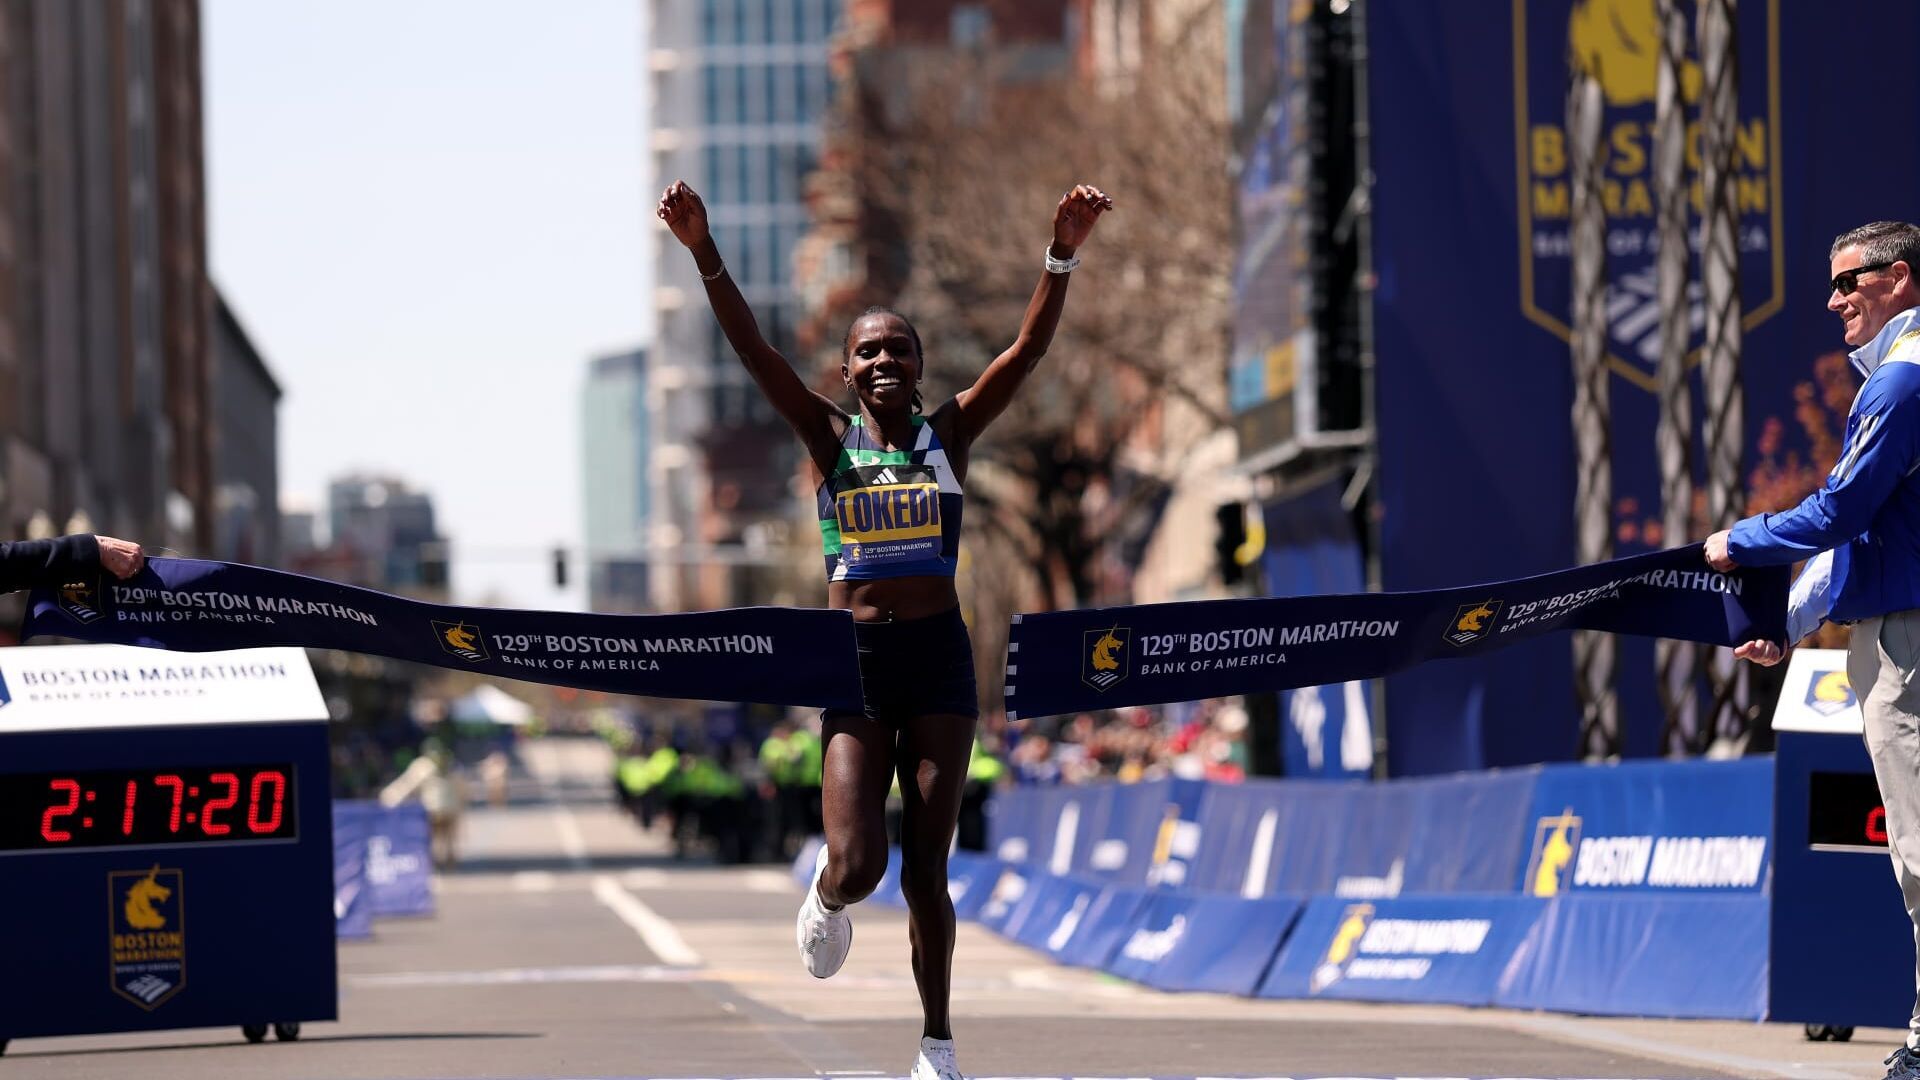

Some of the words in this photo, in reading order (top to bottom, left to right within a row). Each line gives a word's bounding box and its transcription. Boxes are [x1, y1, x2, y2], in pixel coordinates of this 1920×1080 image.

[1532, 119, 1766, 176] BSN
[838, 489, 938, 532] LOKEDI
[877, 544, 901, 553] BOSTON
[901, 541, 933, 551] MARATHON
[112, 586, 157, 604] 129TH
[161, 590, 251, 610] BOSTON
[256, 596, 378, 626] MARATHON
[1507, 599, 1549, 620] 129TH
[1546, 579, 1621, 610] BOSTON
[117, 610, 166, 623] BANK
[171, 611, 193, 622] OF
[198, 611, 276, 625] AMERICA
[1500, 616, 1538, 633] BANK
[1540, 611, 1560, 621] OF
[492, 635, 542, 652] 129TH
[545, 635, 639, 653] BOSTON
[642, 634, 774, 654] MARATHON
[1140, 633, 1187, 656] 129TH
[1189, 627, 1275, 653] BOSTON
[1279, 620, 1399, 646] MARATHON
[501, 655, 549, 669] BANK
[553, 659, 574, 670] OF
[580, 659, 660, 671] AMERICA
[1141, 661, 1186, 675] BANK
[1190, 659, 1212, 672] OF
[1214, 653, 1287, 670] AMERICA
[22, 669, 130, 686] BOSTON
[139, 663, 287, 682] MARATHON
[40, 771, 286, 842] 2:17:20
[1573, 836, 1653, 886] BOSTON
[1648, 836, 1766, 887] MARATHON
[113, 932, 182, 949] BOSTON
[113, 949, 182, 961] MARATHON
